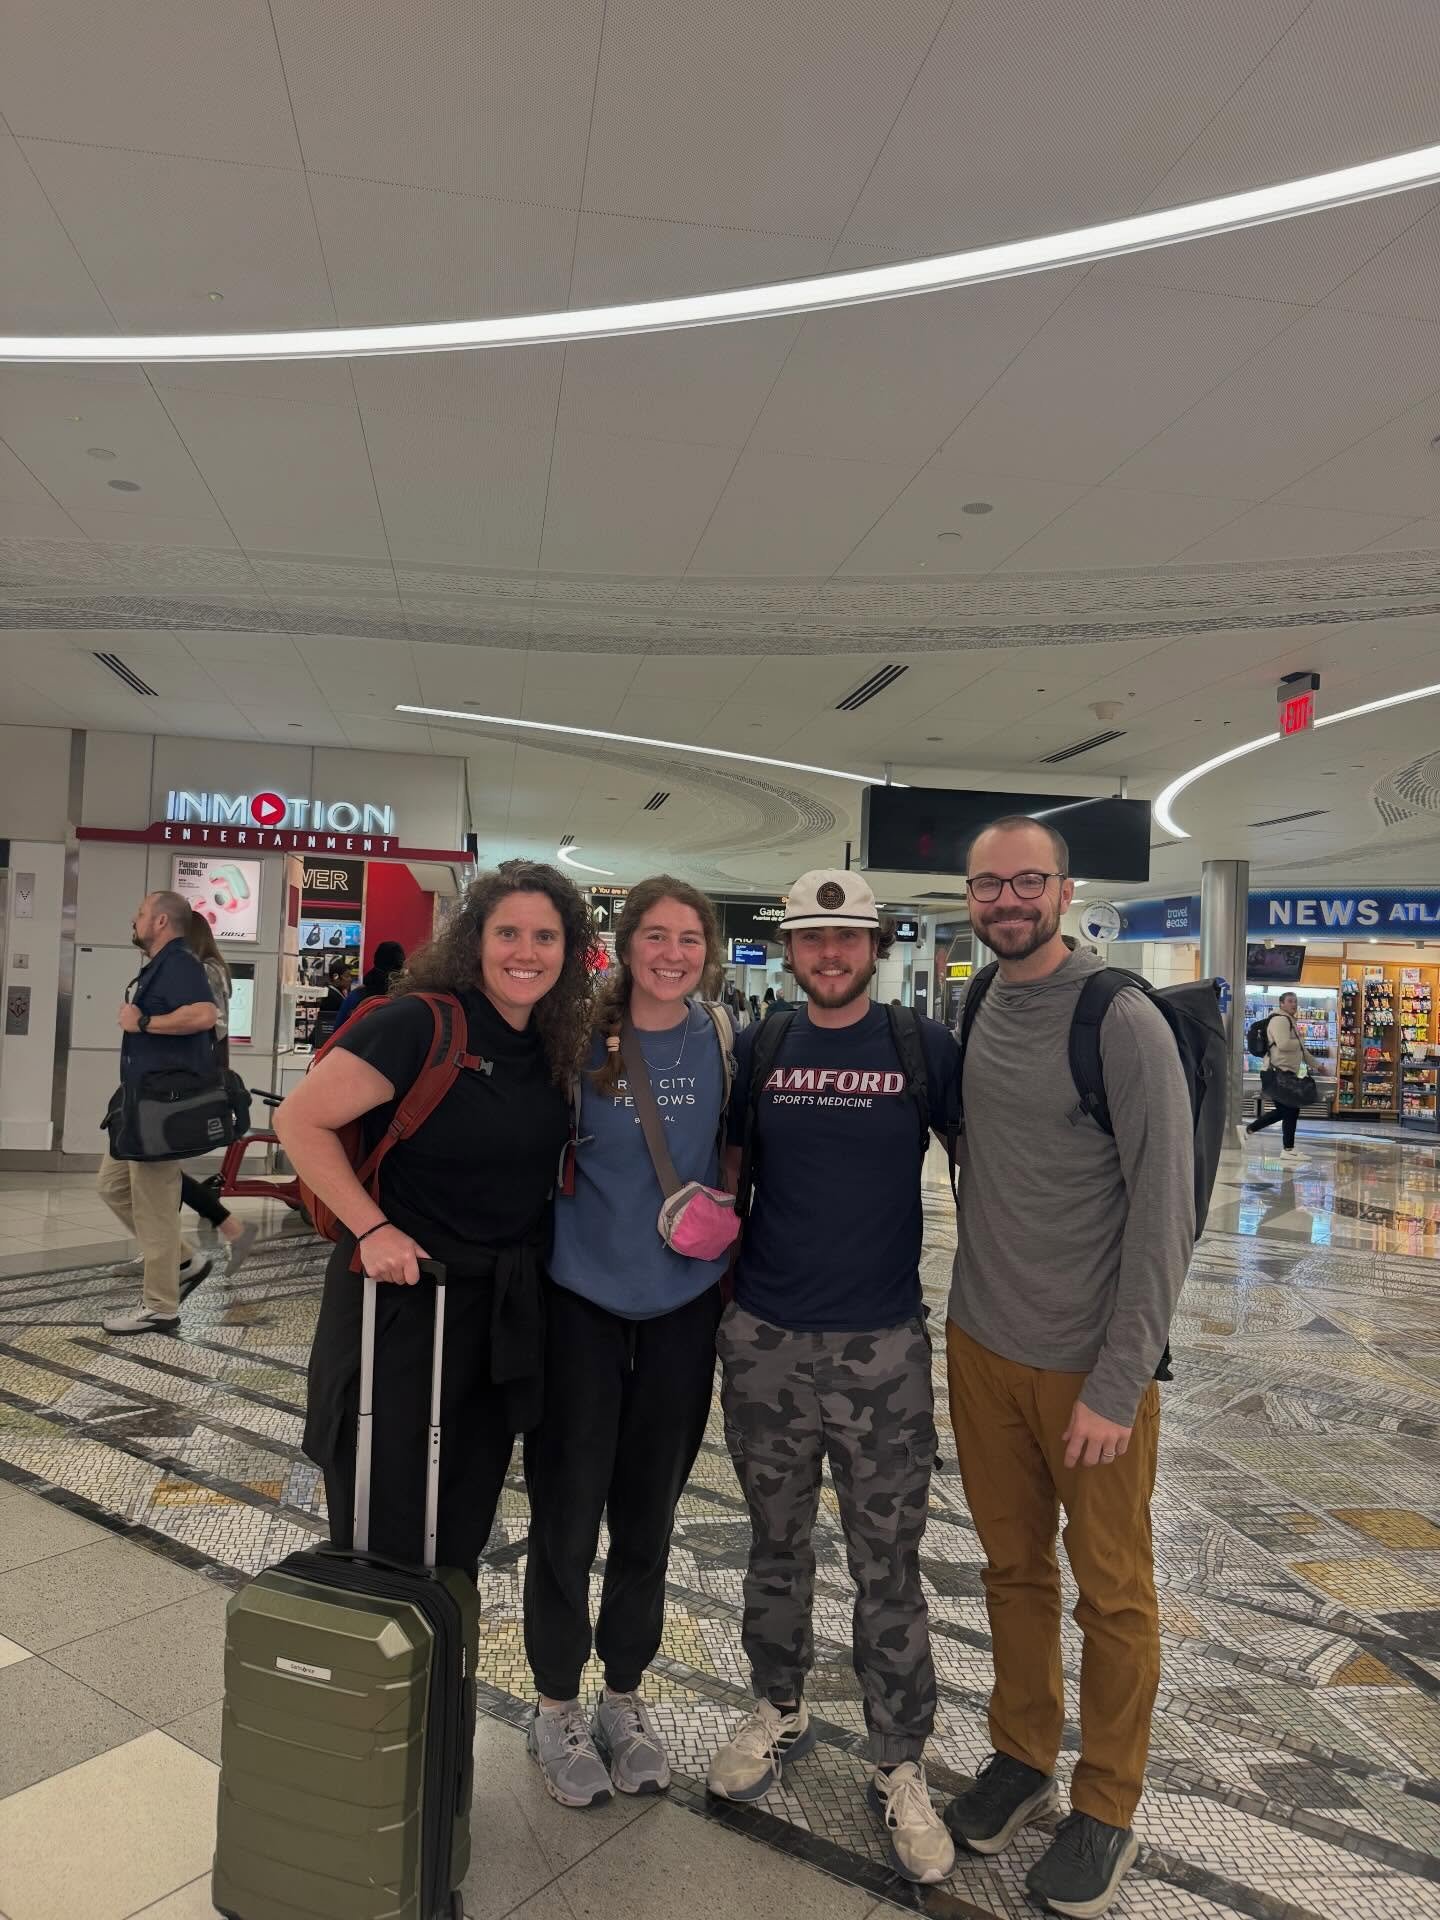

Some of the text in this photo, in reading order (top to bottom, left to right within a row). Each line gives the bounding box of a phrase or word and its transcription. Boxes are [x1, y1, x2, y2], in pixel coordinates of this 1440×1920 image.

[1285, 696, 1309, 735] EXIT
[165, 827, 389, 852] ENTERTAINMENT
[179, 860, 208, 869] Pause for
[760, 907, 785, 917] Gates
[1167, 906, 1188, 918] travel
[1269, 899, 1379, 926] NEWS
[659, 1077, 696, 1089] CITY
[763, 1067, 905, 1096] AMFORD
[613, 1094, 696, 1107] FEOWS
[773, 1095, 873, 1108] SPORTS MEDICINE
[664, 1114, 676, 1122] AL
